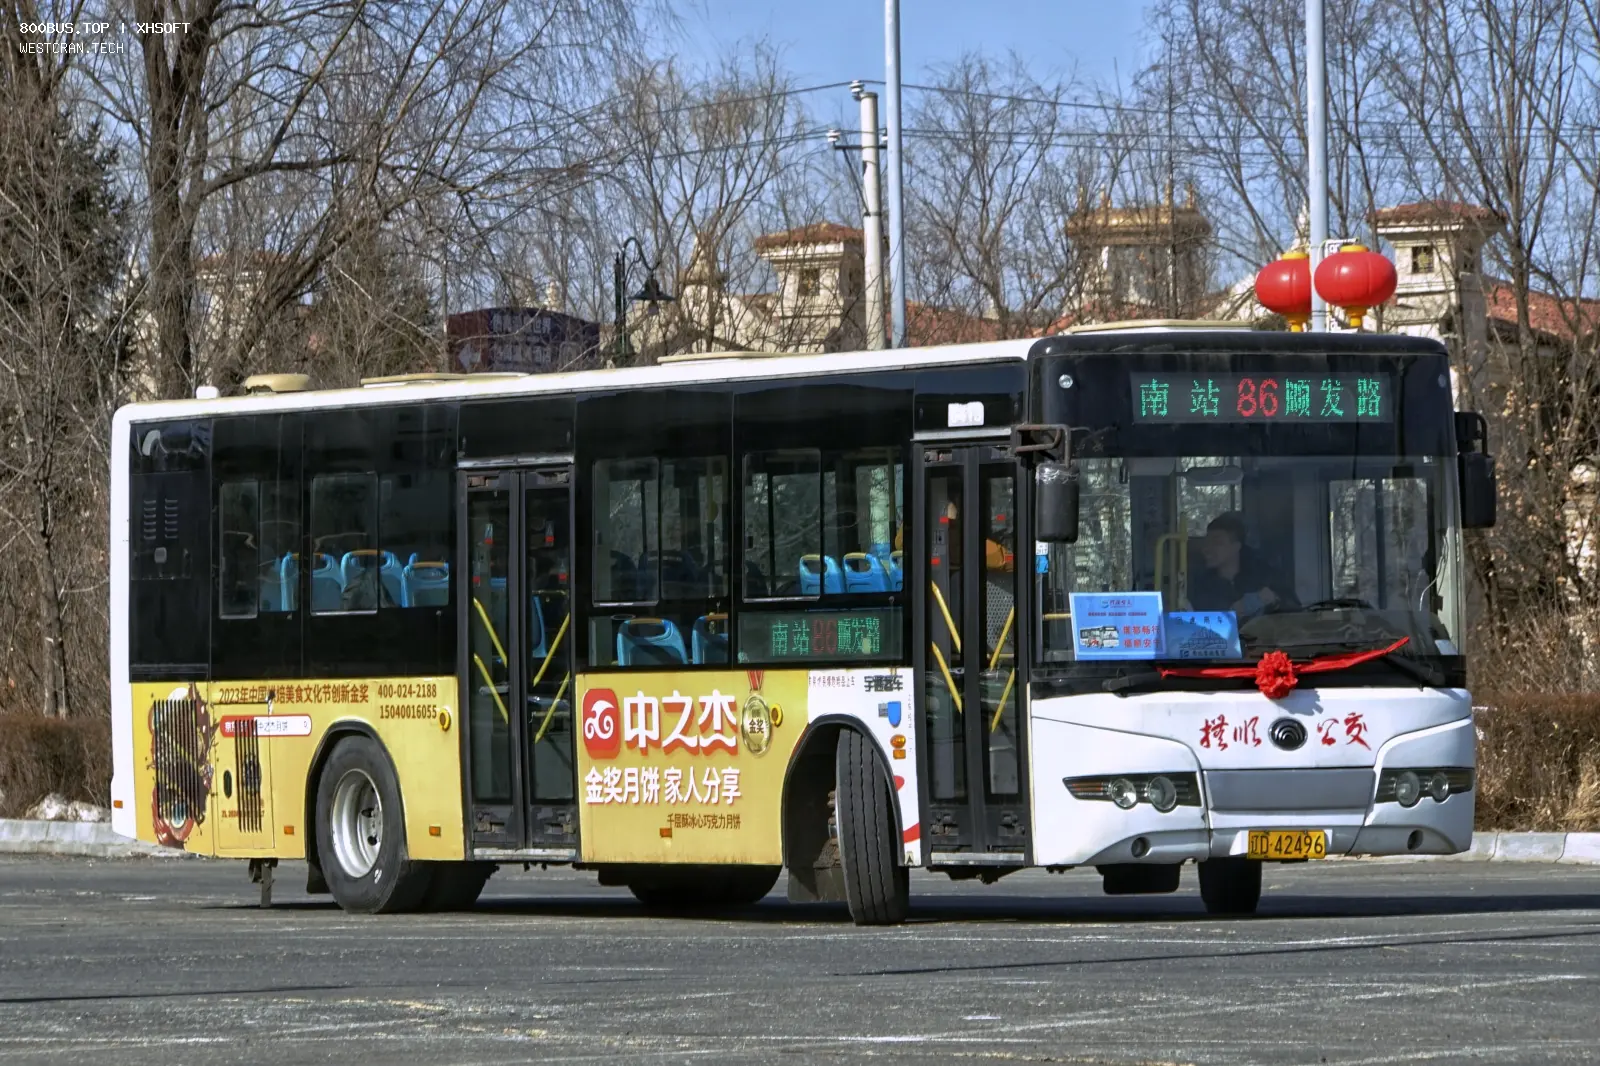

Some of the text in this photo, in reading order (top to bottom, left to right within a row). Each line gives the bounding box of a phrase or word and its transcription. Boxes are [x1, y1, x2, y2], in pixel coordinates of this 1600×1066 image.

[1140, 378, 1220, 417] 南站
[1237, 378, 1279, 417] 86
[377, 684, 437, 698] 400-024-2188
[379, 704, 437, 720] 15040016055
[623, 689, 737, 752] 中之杰
[1317, 712, 1372, 751] 公交
[584, 766, 742, 805] 金奖月饼 家人分享
[667, 813, 741, 830] 千层酥冰心巧克力月饼
